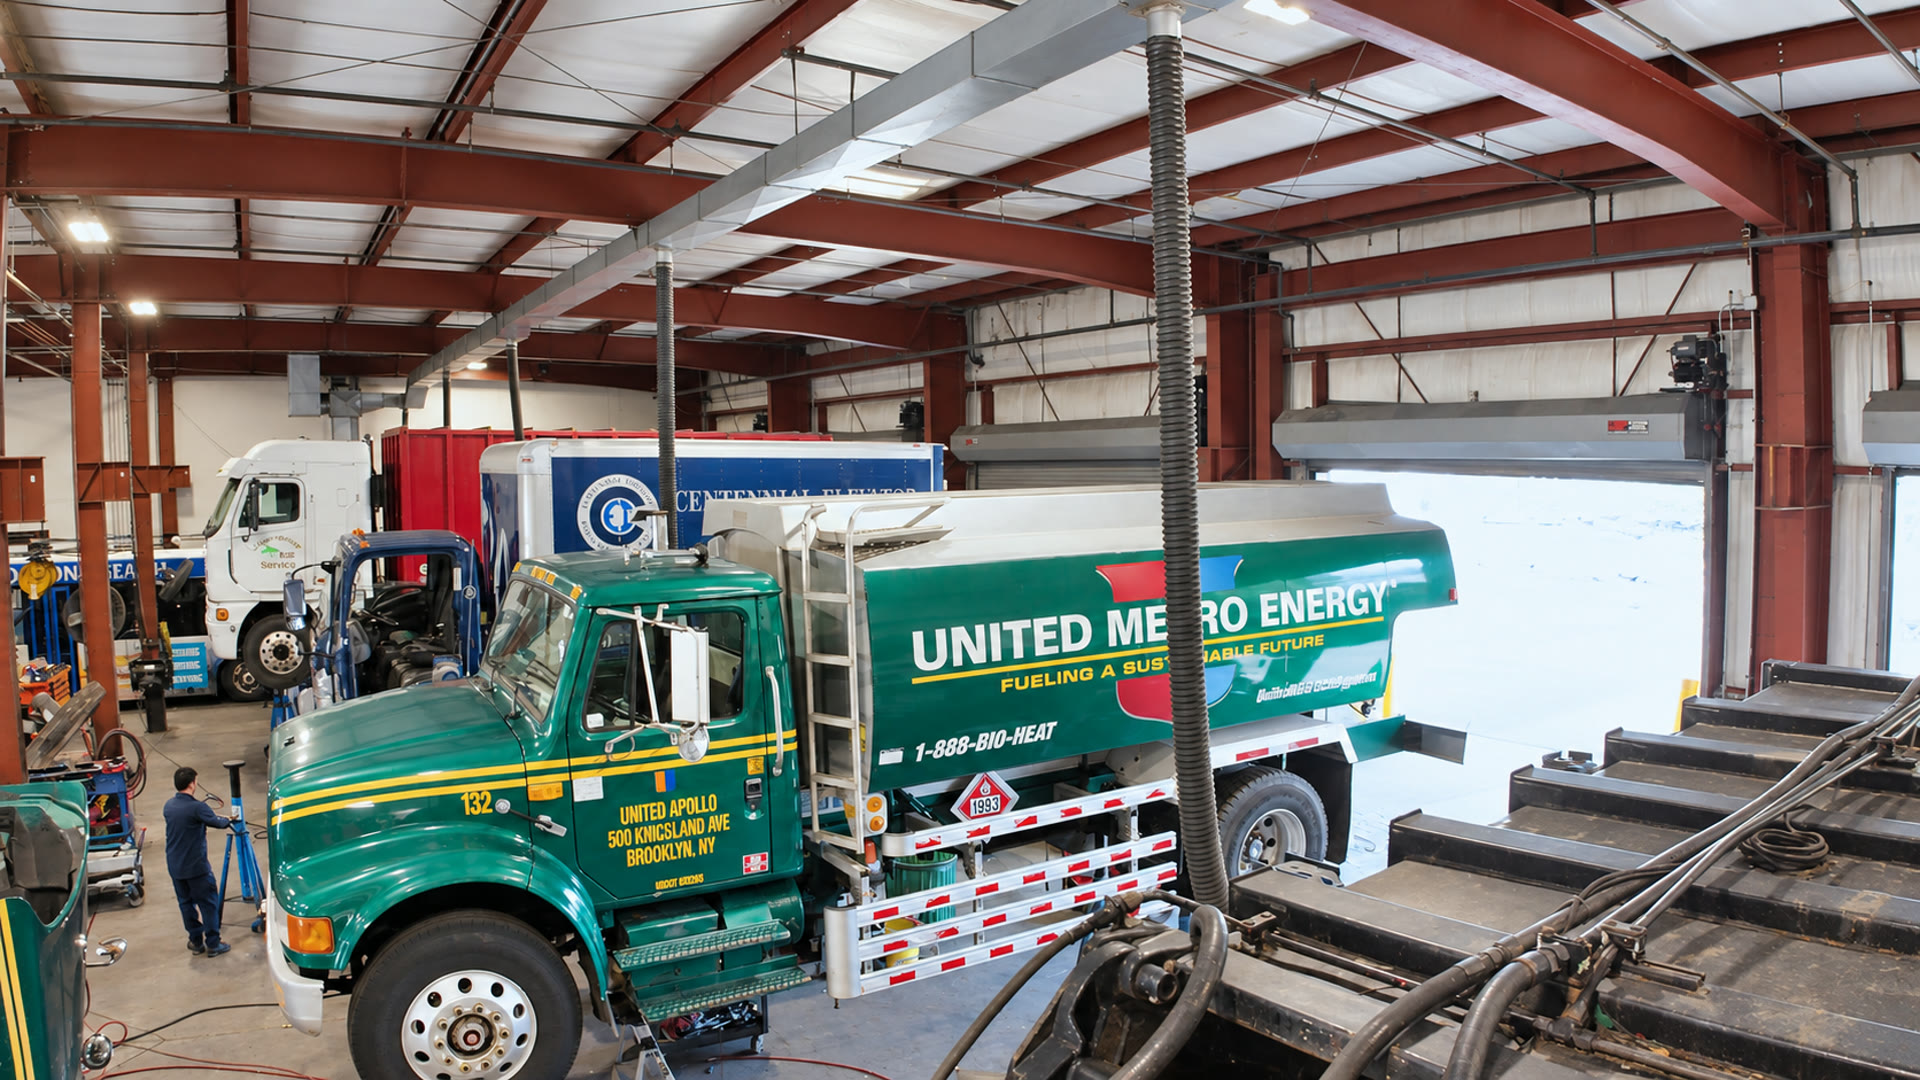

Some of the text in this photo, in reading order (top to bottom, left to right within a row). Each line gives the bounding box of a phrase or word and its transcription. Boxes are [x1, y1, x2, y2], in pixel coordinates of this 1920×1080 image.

[911, 581, 1388, 671] UNITED MERO ENERGY
[1000, 634, 1325, 693] FUELING A SUSABLE FUTURE
[915, 721, 1058, 762] 1-888-BIO-HEAT
[460, 790, 494, 816] 132
[620, 793, 718, 825] UNITED APOLLO
[973, 796, 999, 814] 1993
[607, 829, 632, 848] 500
[707, 813, 731, 834] AVE
[698, 836, 716, 856] NY
